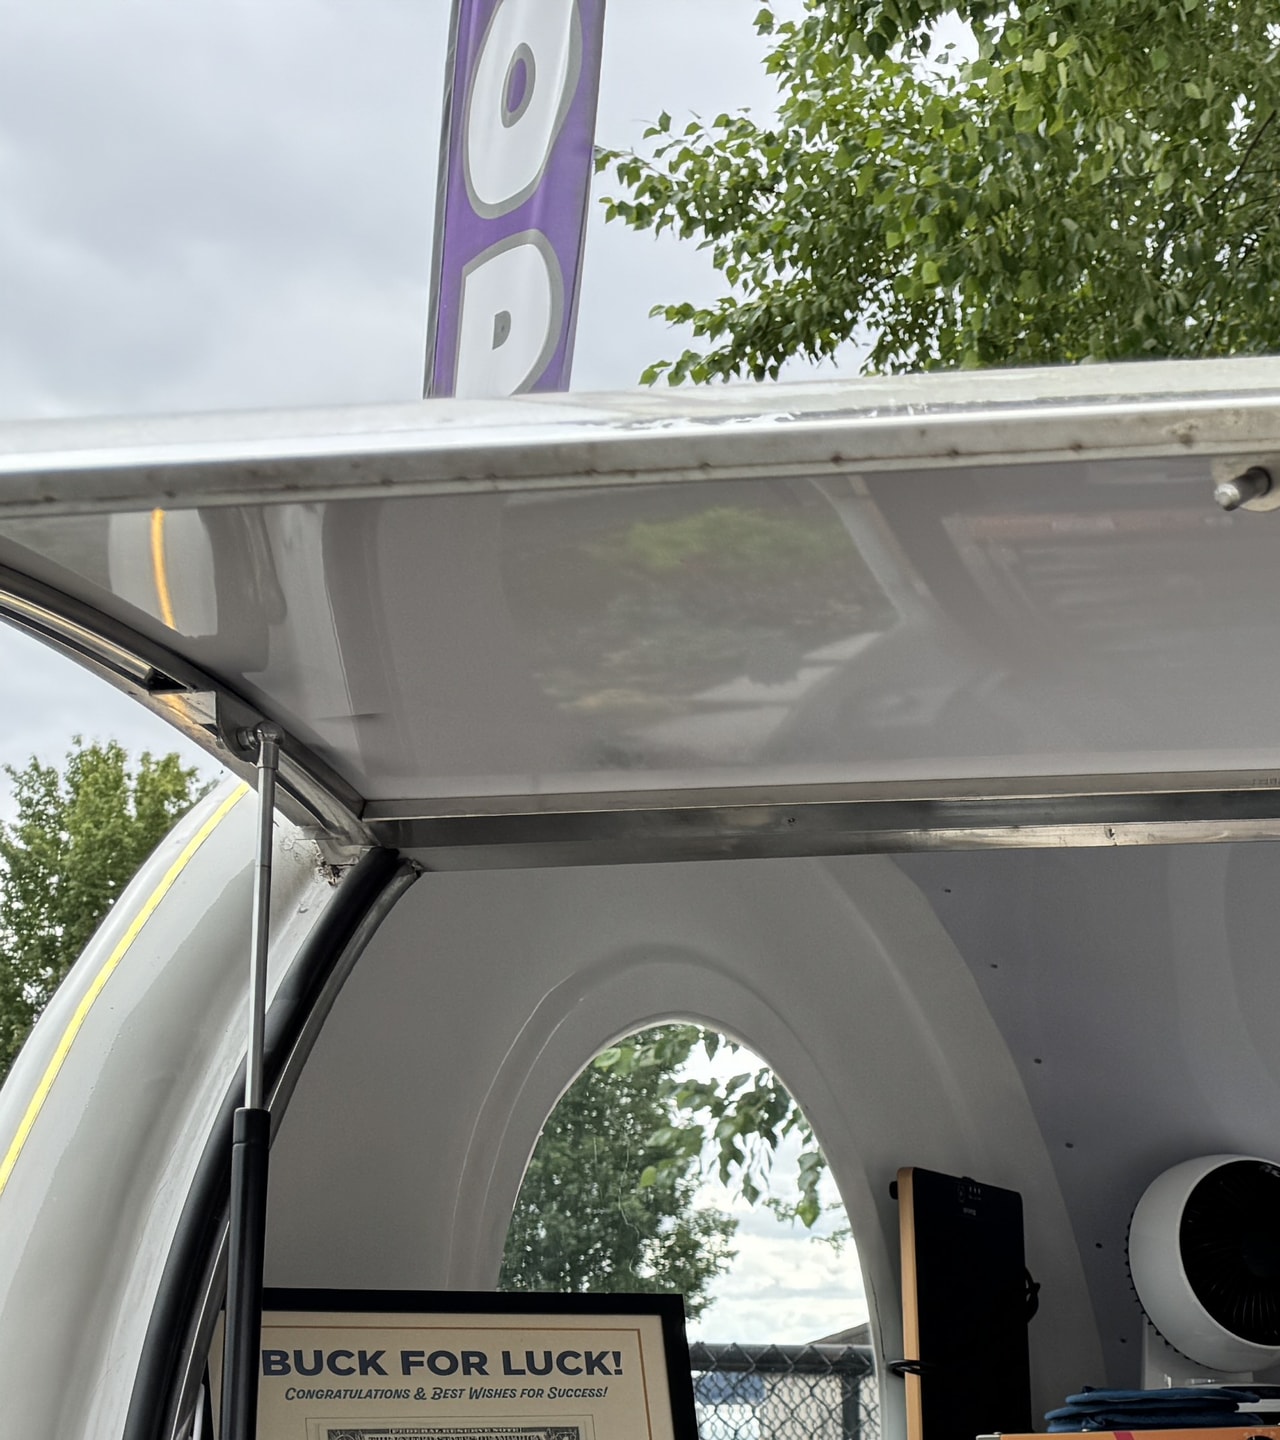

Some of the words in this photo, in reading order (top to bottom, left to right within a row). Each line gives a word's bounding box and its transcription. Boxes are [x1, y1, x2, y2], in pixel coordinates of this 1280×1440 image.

[262, 1349, 388, 1377] BUCK
[400, 1350, 490, 1376] FOR
[502, 1350, 623, 1376] LUCK!
[413, 1388, 427, 1400] &
